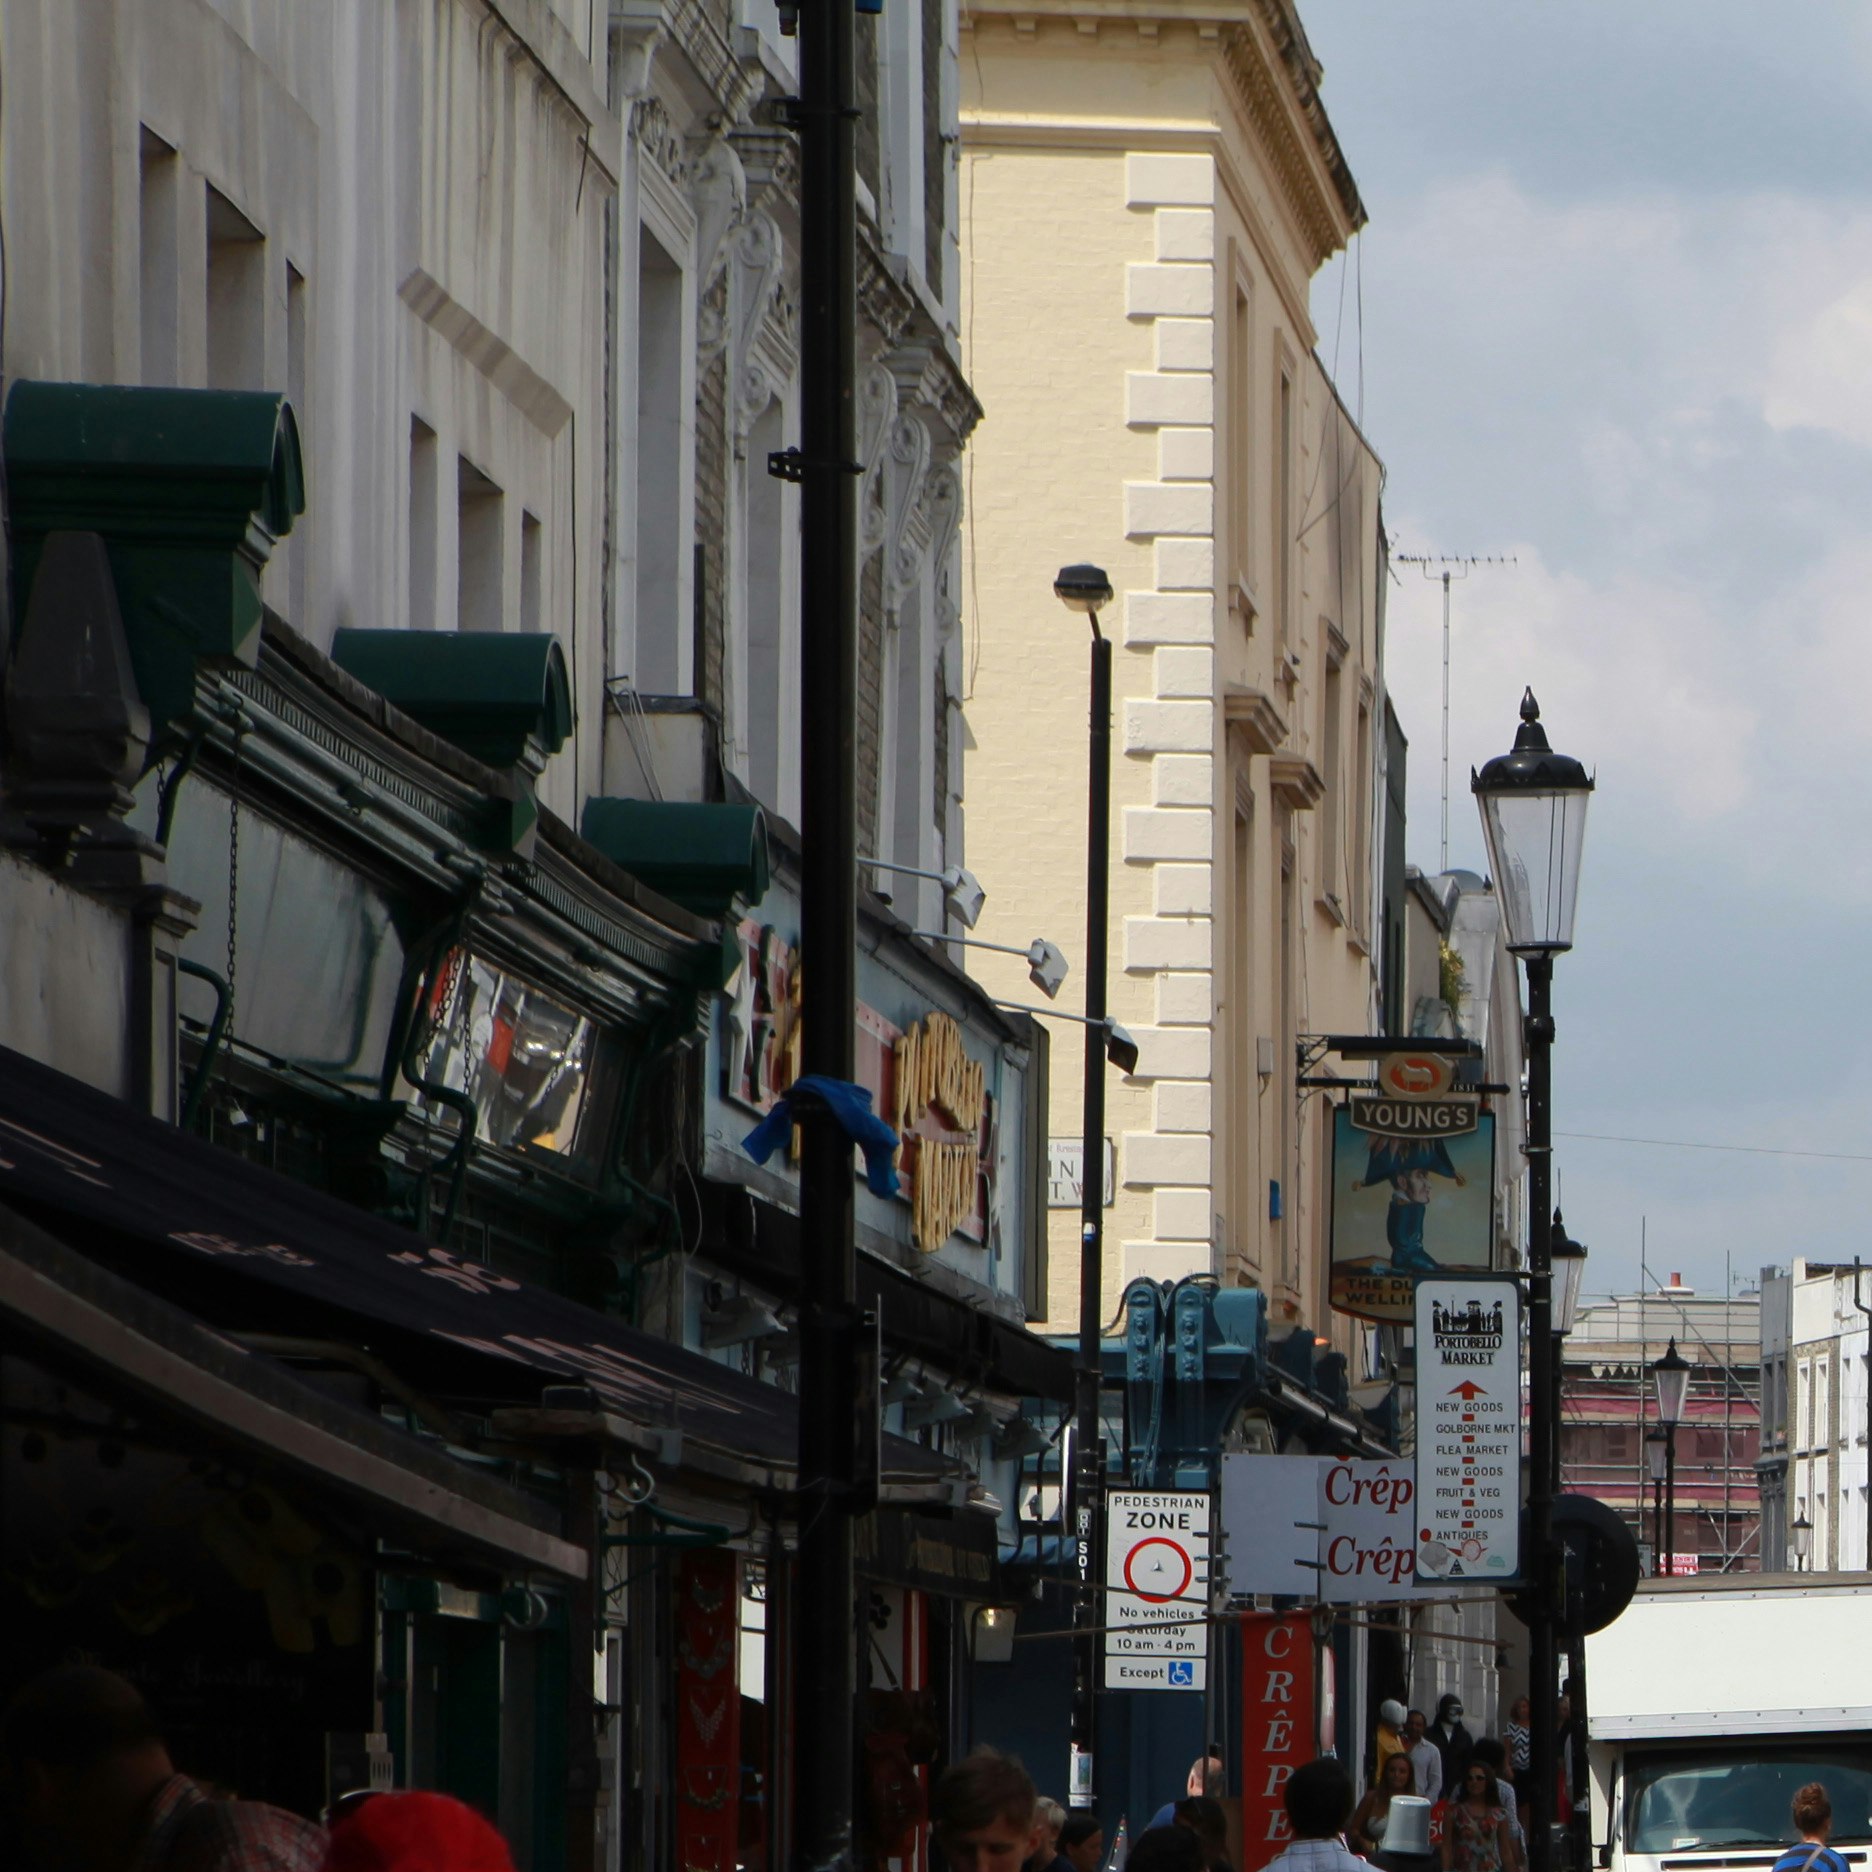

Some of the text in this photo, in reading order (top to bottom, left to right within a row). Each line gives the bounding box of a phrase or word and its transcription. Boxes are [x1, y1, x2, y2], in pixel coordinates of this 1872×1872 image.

[1361, 1103, 1468, 1129] YOUNG'S
[1348, 1278, 1383, 1290] THE
[1344, 1292, 1413, 1306] WELLI
[1434, 1335, 1502, 1349] PORTOBELLO
[1441, 1351, 1494, 1365] MARKET
[1436, 1403, 1503, 1412] NEW GOODS
[1436, 1424, 1515, 1434] GOLBORNE MKT
[1436, 1445, 1508, 1455] FLEA MARKET
[1436, 1467, 1503, 1476] NEW GOODS
[1325, 1466, 1413, 1514] Crêp
[1436, 1488, 1500, 1497] FRUIT & VEG
[1114, 1496, 1204, 1509] PEDESTRIAN
[1126, 1512, 1190, 1529] ZONE
[1436, 1509, 1504, 1519] NEW GOODS
[1436, 1531, 1488, 1540] ANTIQUES
[1328, 1536, 1415, 1584] Crêp
[1119, 1607, 1195, 1620] No vehicles
[1117, 1639, 1131, 1649] 10
[1135, 1641, 1154, 1650] am
[1164, 1639, 1172, 1650] 4
[1176, 1641, 1195, 1652] pm
[1119, 1666, 1164, 1679] Except
[1261, 1626, 1294, 1860] CRÊPE
